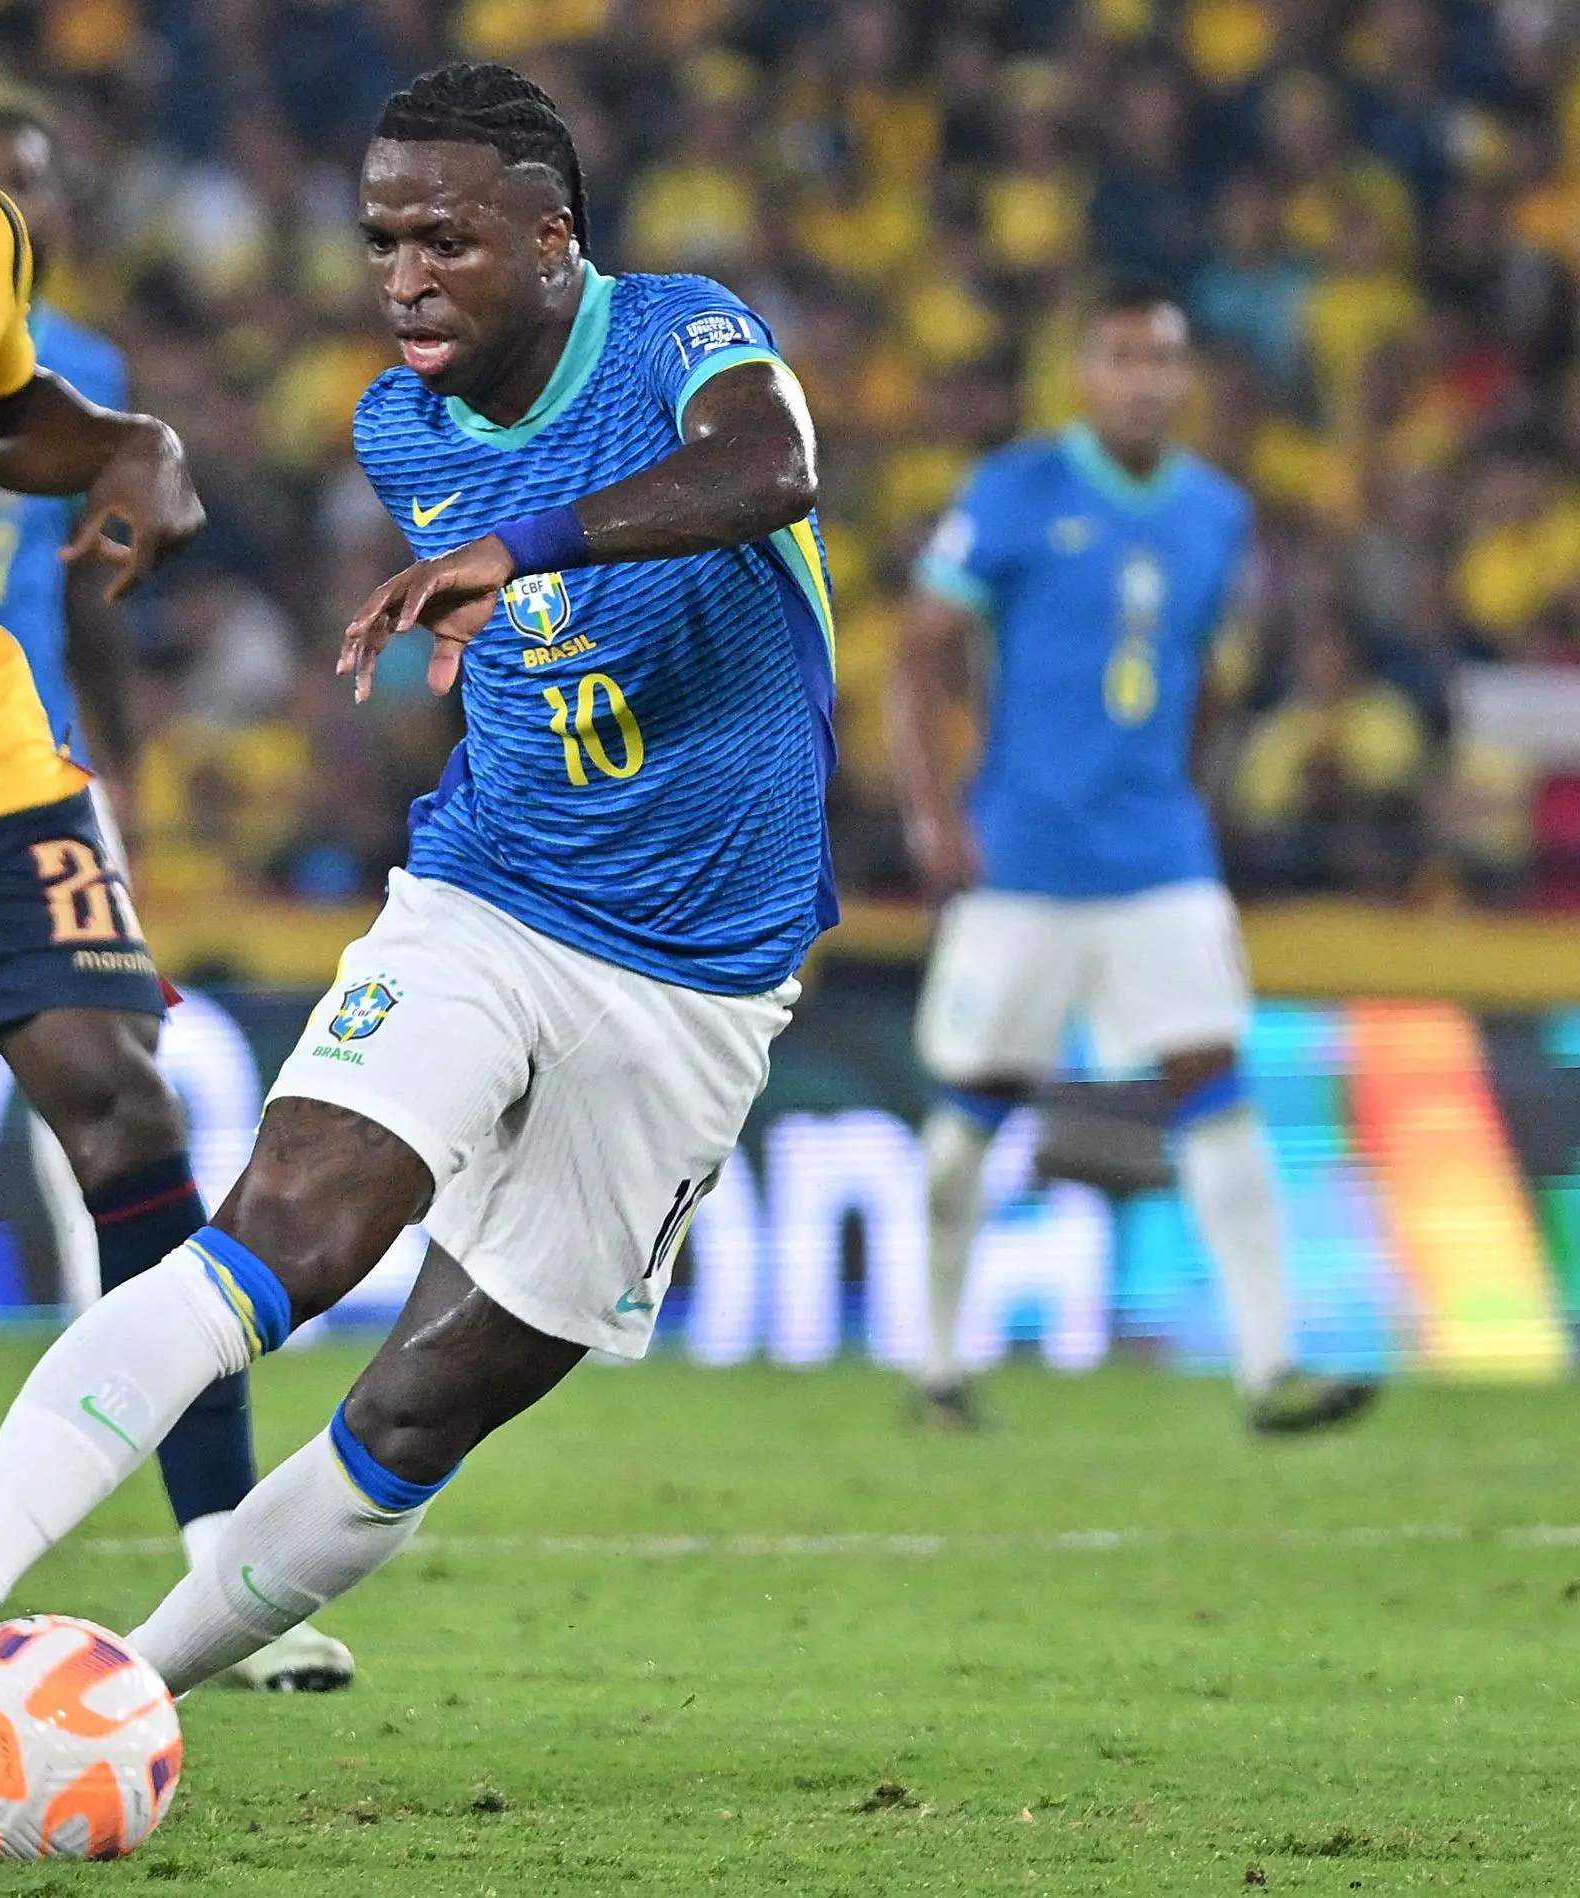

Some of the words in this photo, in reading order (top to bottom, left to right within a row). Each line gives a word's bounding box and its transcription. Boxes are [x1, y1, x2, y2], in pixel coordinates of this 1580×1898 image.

[521, 580, 545, 596] CBF
[522, 634, 597, 669] BRASIL
[542, 672, 645, 786] 10
[312, 1046, 365, 1066] BRASIL
